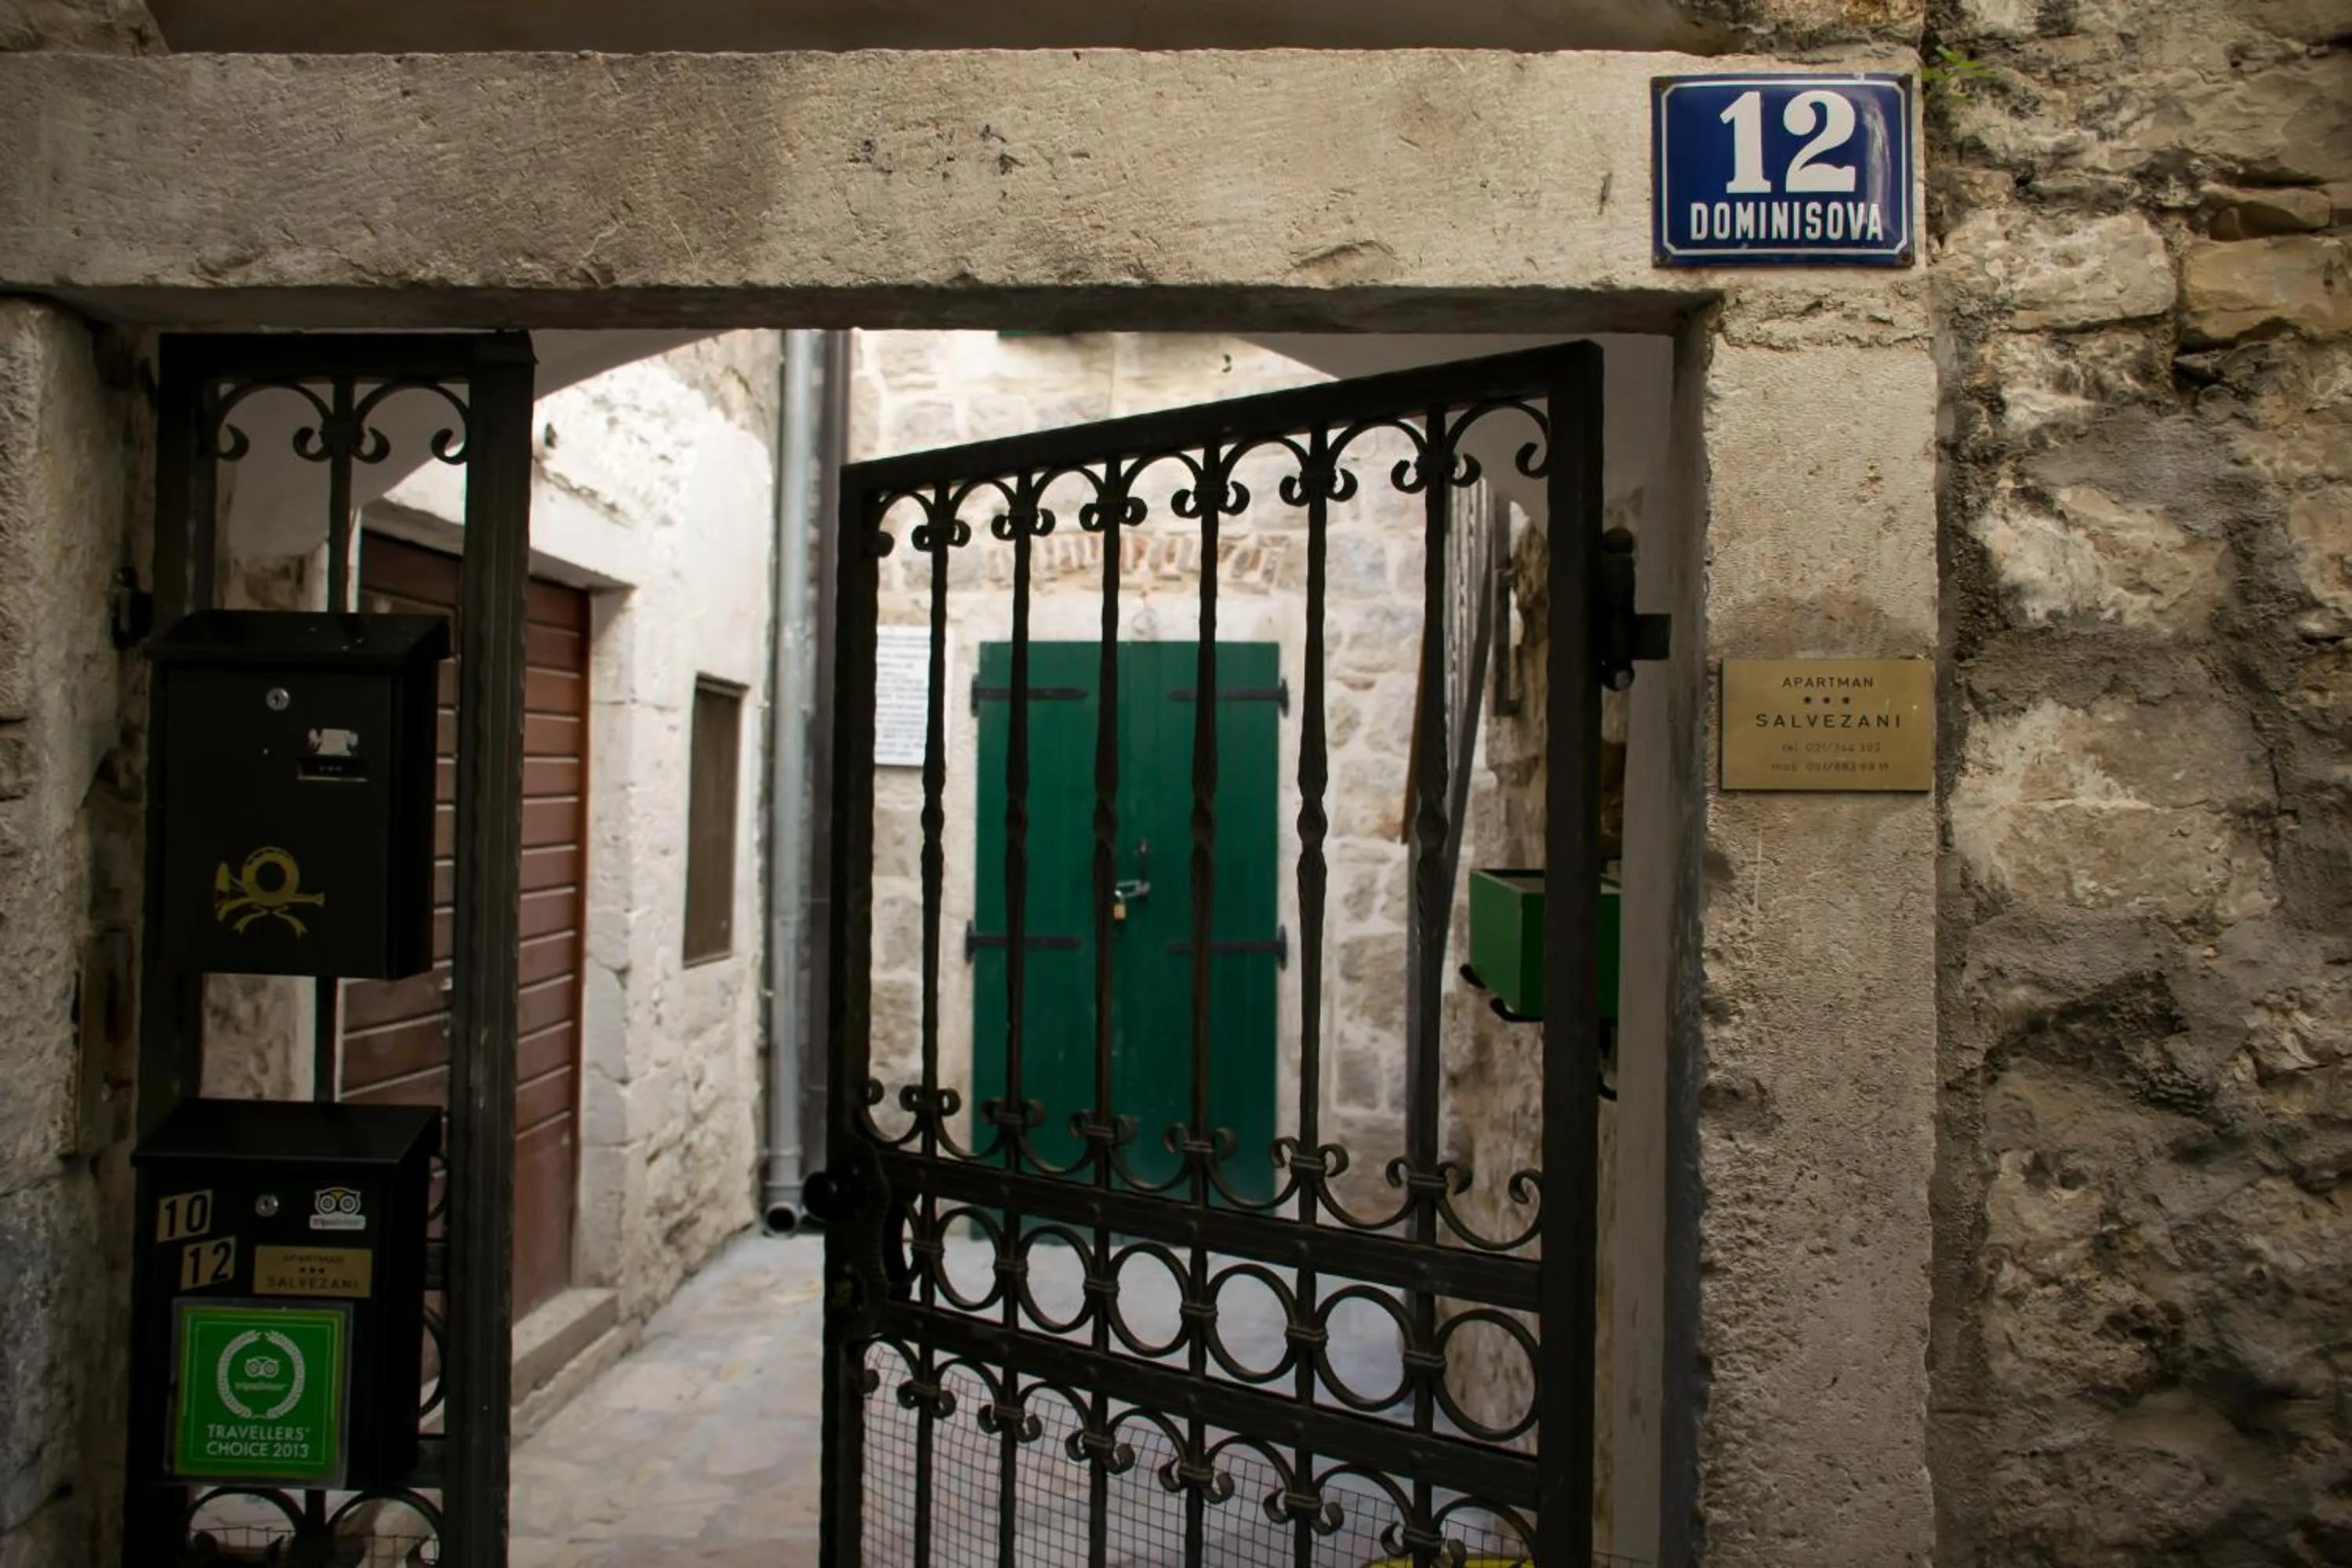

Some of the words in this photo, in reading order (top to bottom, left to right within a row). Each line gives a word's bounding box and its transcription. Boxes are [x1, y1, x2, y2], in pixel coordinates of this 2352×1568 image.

[1719, 90, 1857, 194] 12
[1690, 201, 1884, 241] DOMINISOVA
[1781, 676, 1875, 688] APARTMAN
[1755, 713, 1901, 729] SALVEZANI
[164, 1193, 209, 1239] 10
[187, 1241, 233, 1286] 12
[205, 1441, 268, 1457] CHOICE
[272, 1443, 310, 1458] 2013
